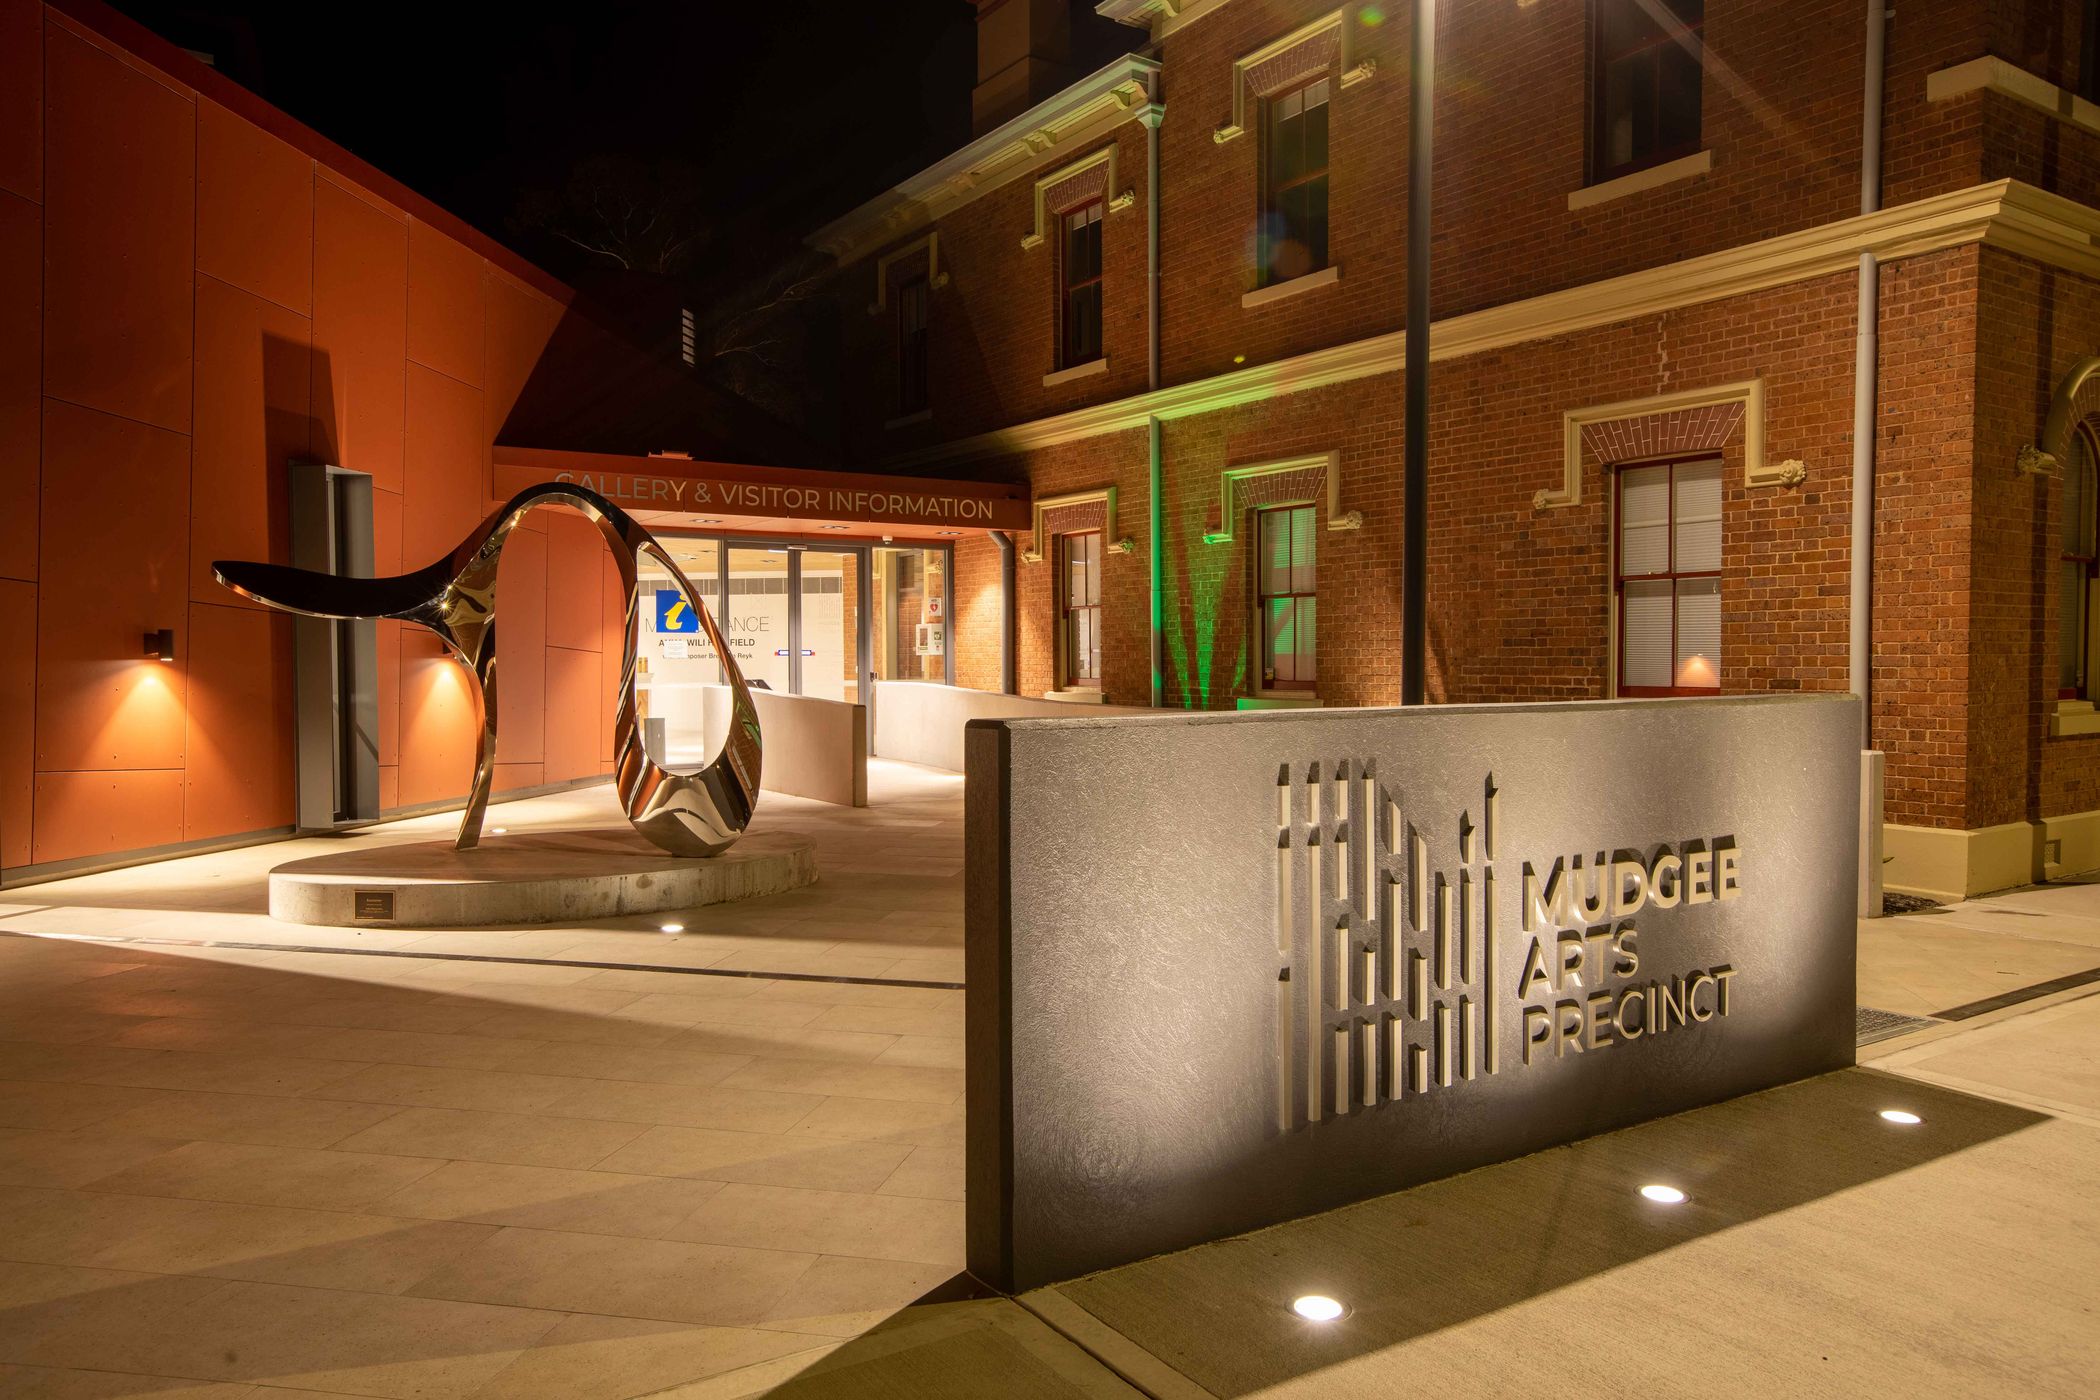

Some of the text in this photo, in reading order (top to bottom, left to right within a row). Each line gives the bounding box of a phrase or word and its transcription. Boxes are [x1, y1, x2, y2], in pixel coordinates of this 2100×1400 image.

[694, 482, 711, 504] &
[718, 483, 820, 510] VISITOR
[829, 490, 994, 519] INFORMATION
[1523, 847, 1742, 932] MUDGEE
[1519, 928, 1640, 1000] ARTS
[1523, 968, 1739, 1067] PRECINCT
